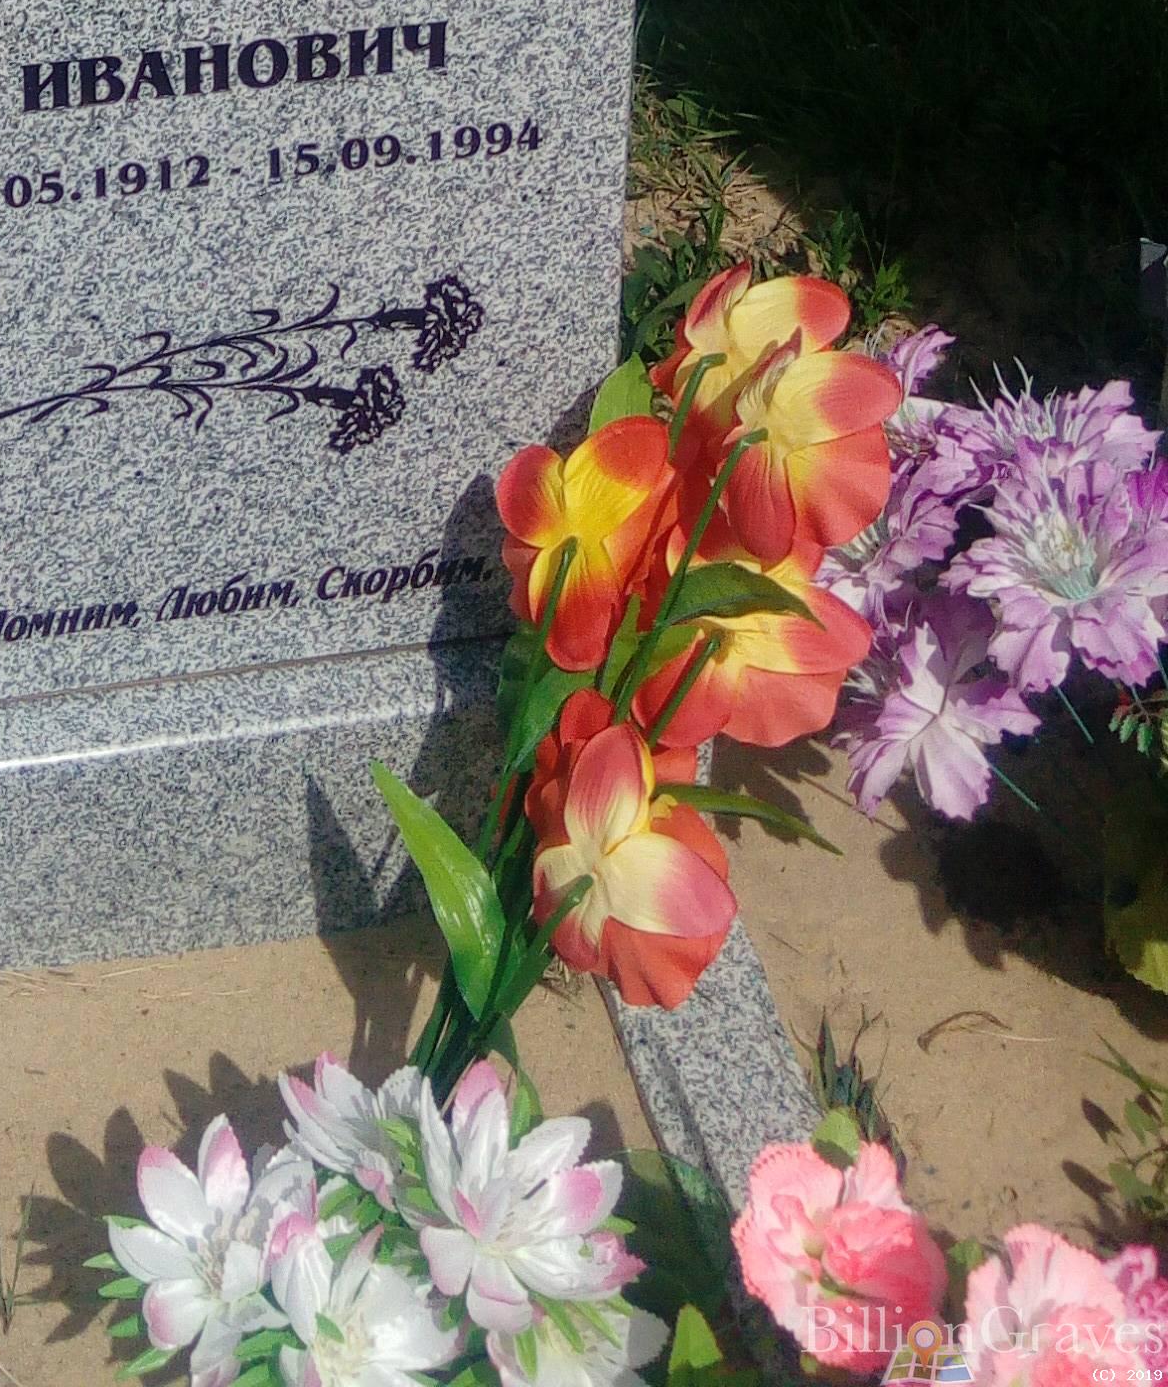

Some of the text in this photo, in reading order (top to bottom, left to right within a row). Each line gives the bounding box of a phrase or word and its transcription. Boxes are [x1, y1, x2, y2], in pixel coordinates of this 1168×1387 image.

[22, 21, 448, 112] ИВАНОВИЧ
[268, 117, 543, 185] 15.09.1994
[154, 571, 300, 622] Любим,
